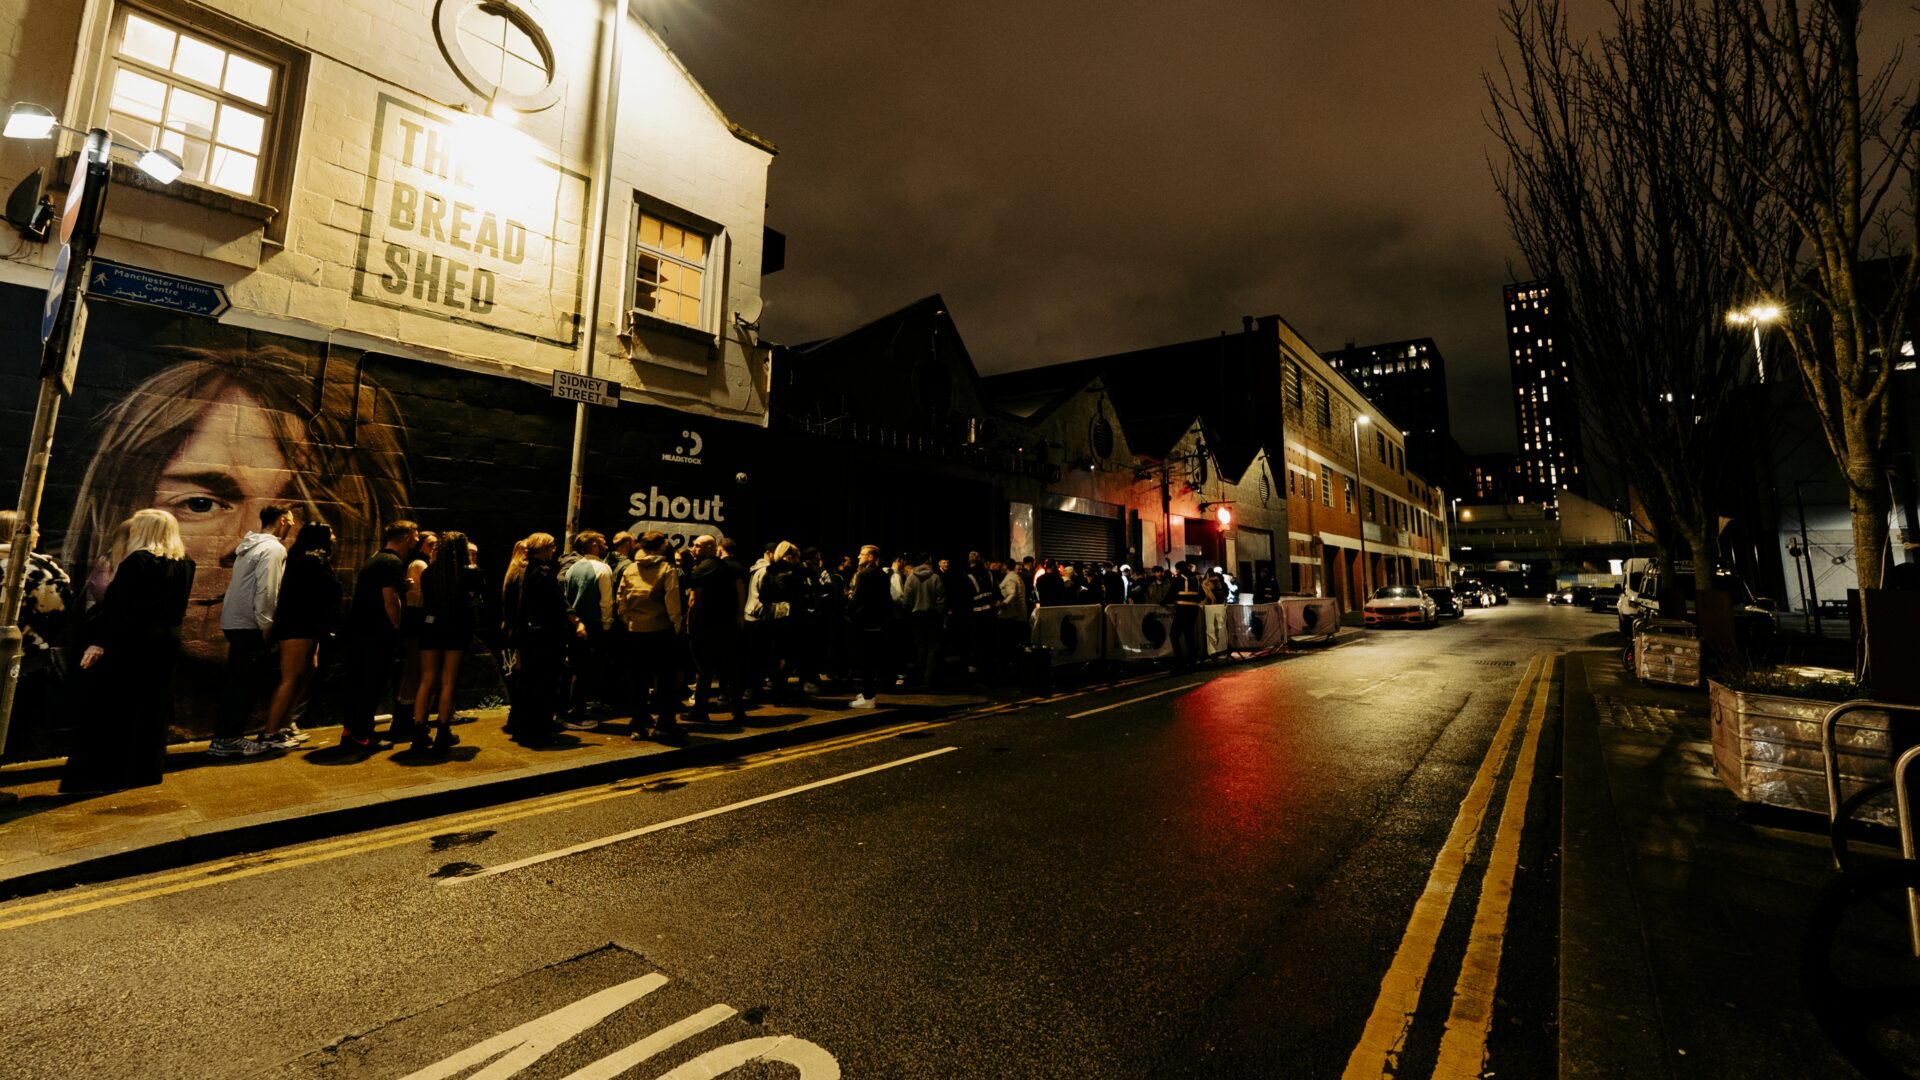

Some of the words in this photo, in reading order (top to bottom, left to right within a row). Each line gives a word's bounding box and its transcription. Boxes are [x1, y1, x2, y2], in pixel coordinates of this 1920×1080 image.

[389, 180, 527, 265] BREAD
[113, 268, 173, 287] Manchester
[176, 282, 210, 296] Islamic
[144, 283, 180, 297] Centre
[381, 244, 496, 315] SHED
[558, 386, 602, 403] STREET
[559, 374, 602, 392] SIDNEY
[661, 453, 702, 465] HEADSTOCK
[628, 486, 724, 522] shout
